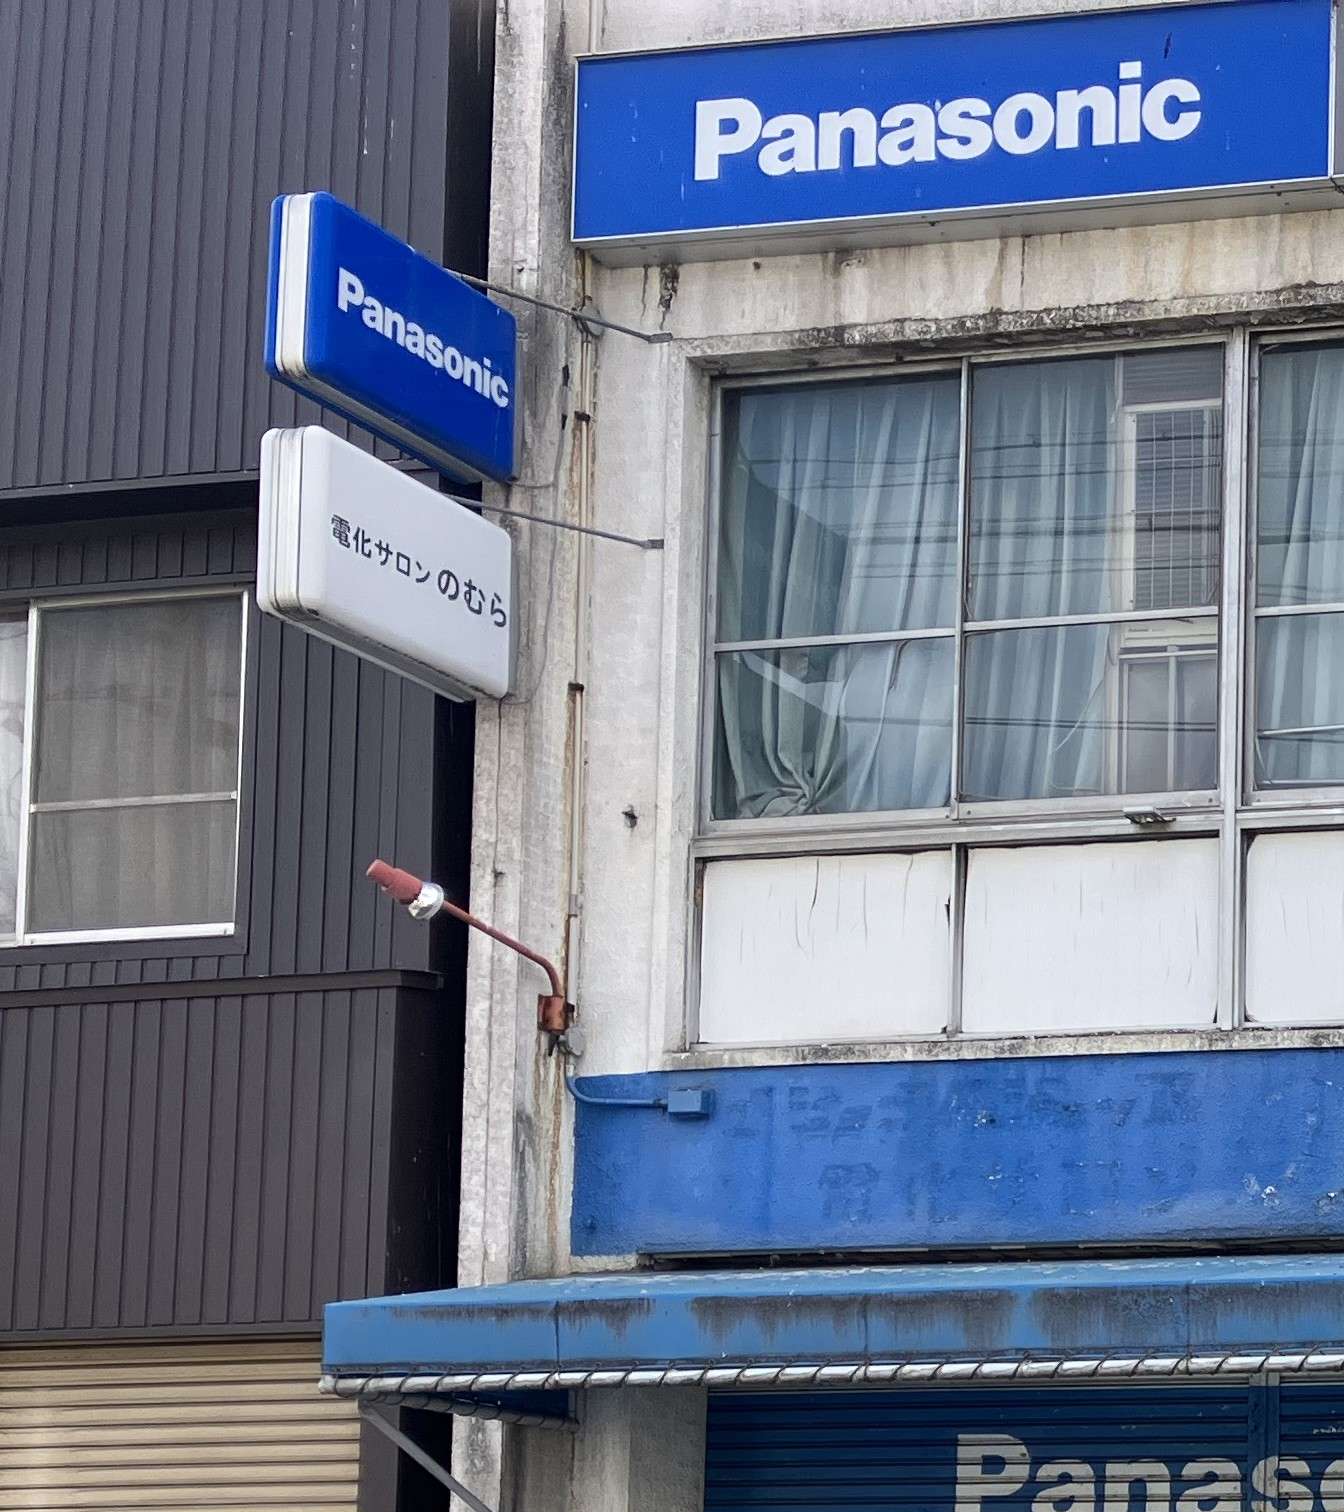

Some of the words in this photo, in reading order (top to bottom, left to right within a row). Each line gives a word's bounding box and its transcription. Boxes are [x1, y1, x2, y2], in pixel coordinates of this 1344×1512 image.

[693, 61, 1202, 182] Panasonic
[337, 265, 510, 410] Panasonic
[329, 512, 432, 585] 電化サロン
[437, 567, 509, 629] のむら
